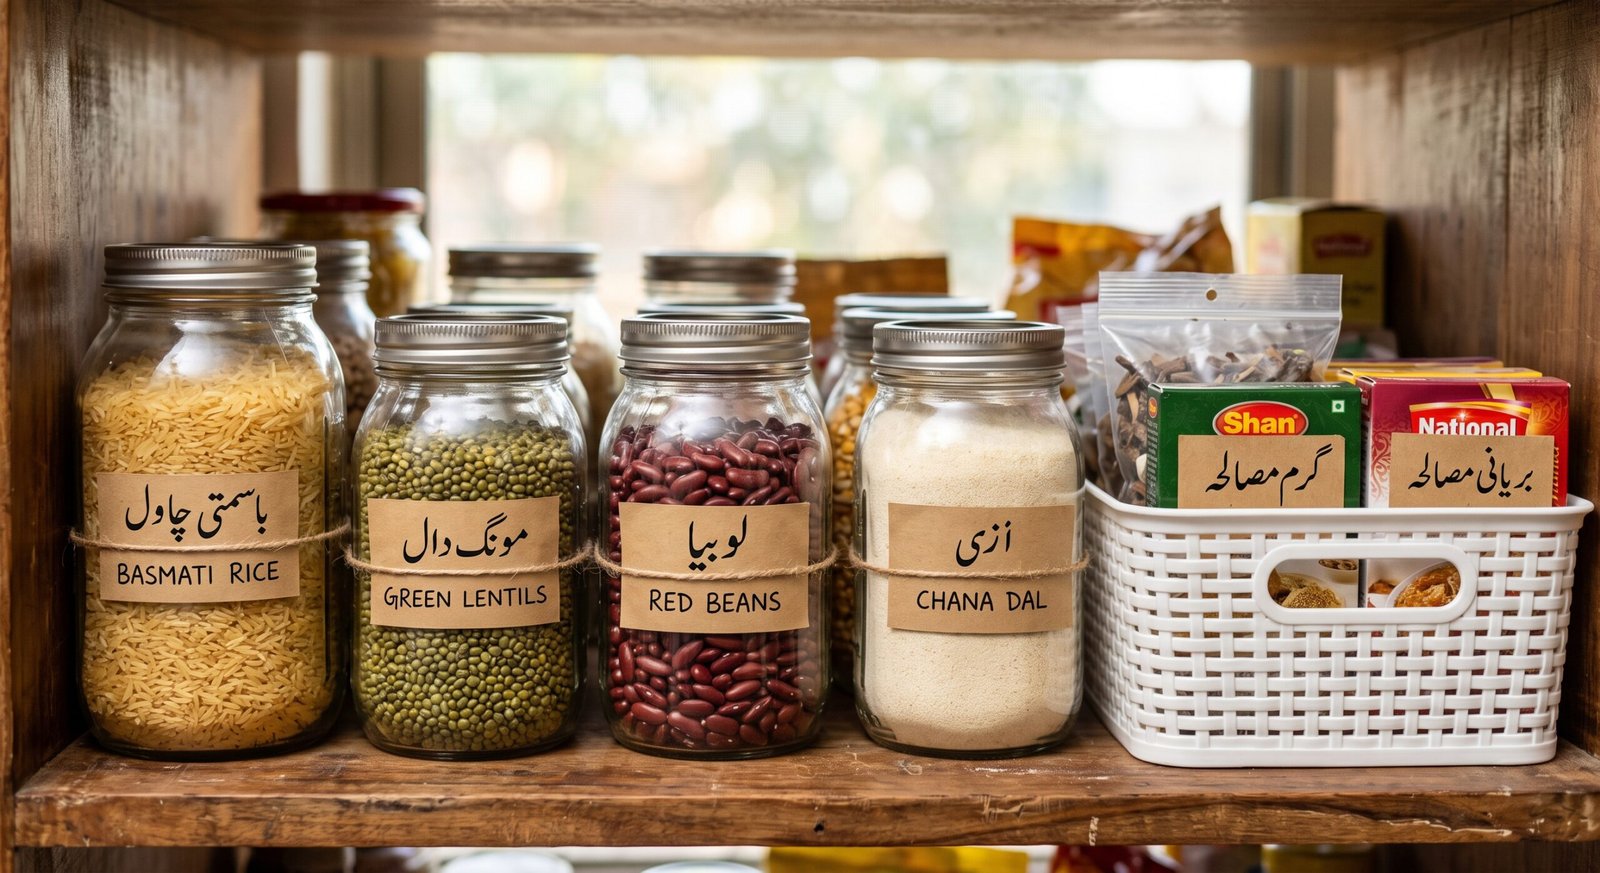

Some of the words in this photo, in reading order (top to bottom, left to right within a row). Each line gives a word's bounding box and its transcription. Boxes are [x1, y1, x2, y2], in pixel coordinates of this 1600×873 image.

[1223, 412, 1296, 434] Shan
[1418, 417, 1517, 436] National
[1279, 443, 1333, 507] گرم
[125, 483, 192, 543] چاول
[197, 488, 268, 540] باسمتی
[402, 516, 452, 564] دال
[455, 512, 529, 558] مونگ
[688, 514, 748, 572] لوبیا
[117, 562, 213, 586] BASMATI
[229, 560, 280, 585] RICE
[384, 586, 451, 610] GREEN
[463, 584, 548, 608] LENTILS
[649, 588, 693, 613] RED
[706, 590, 781, 615] BEANS
[916, 590, 994, 612] CHANA
[1005, 589, 1048, 612] DAL
